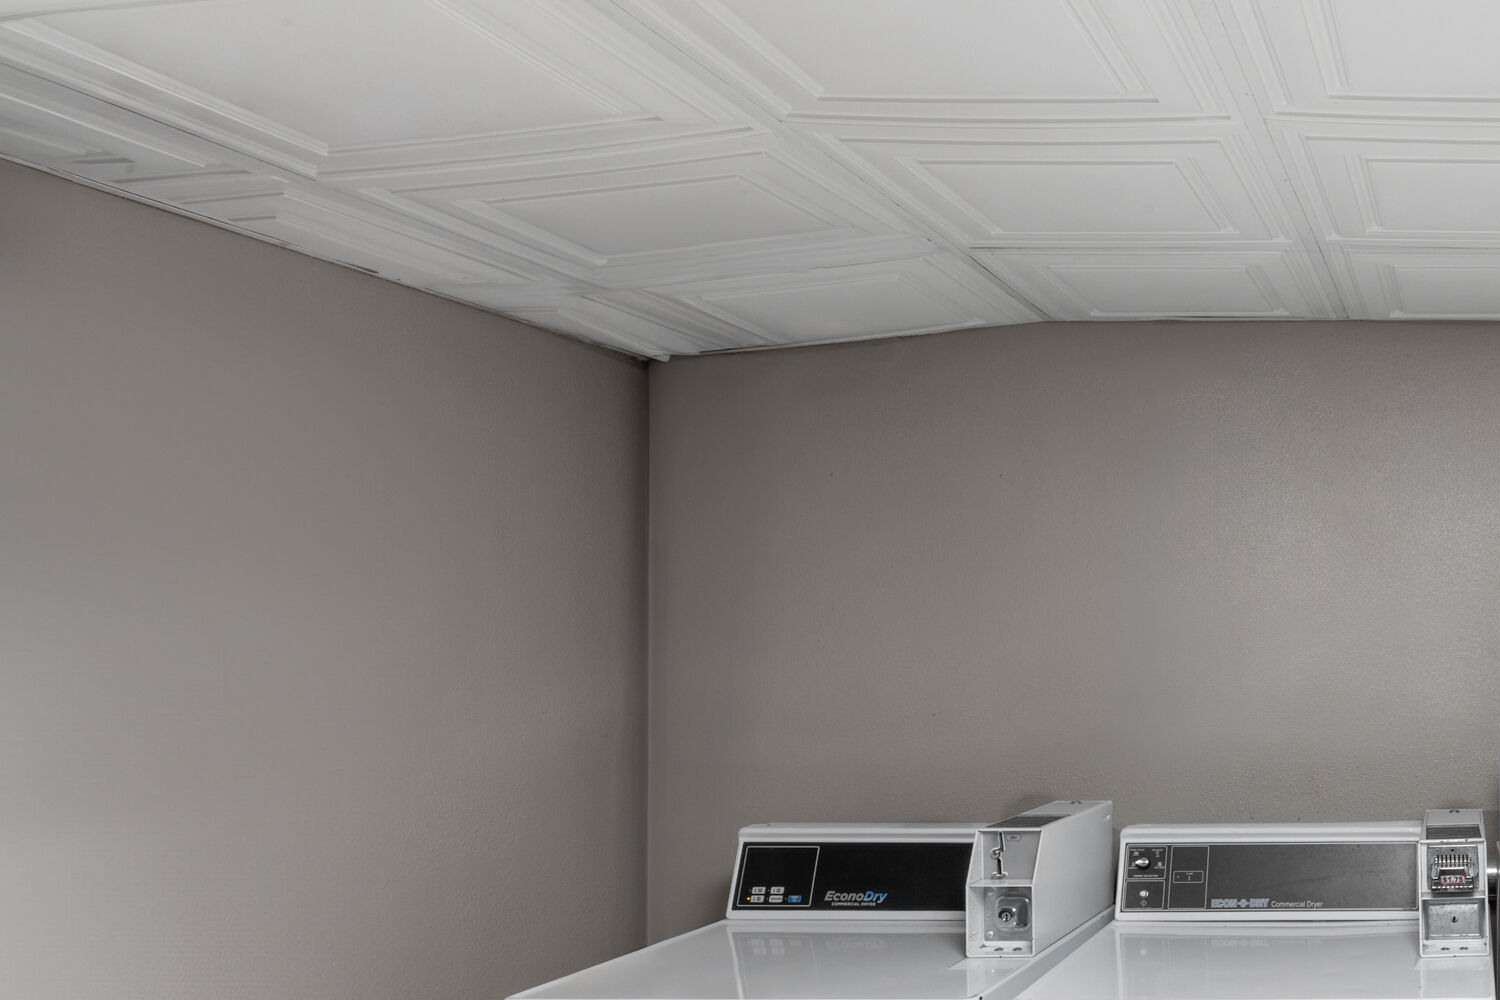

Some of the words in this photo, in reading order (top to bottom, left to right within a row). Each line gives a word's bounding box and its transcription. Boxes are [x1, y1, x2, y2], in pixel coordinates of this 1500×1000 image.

[824, 890, 888, 904] EconoDry
[1271, 900, 1305, 908] Commercial
[1306, 900, 1323, 909] Dryer
